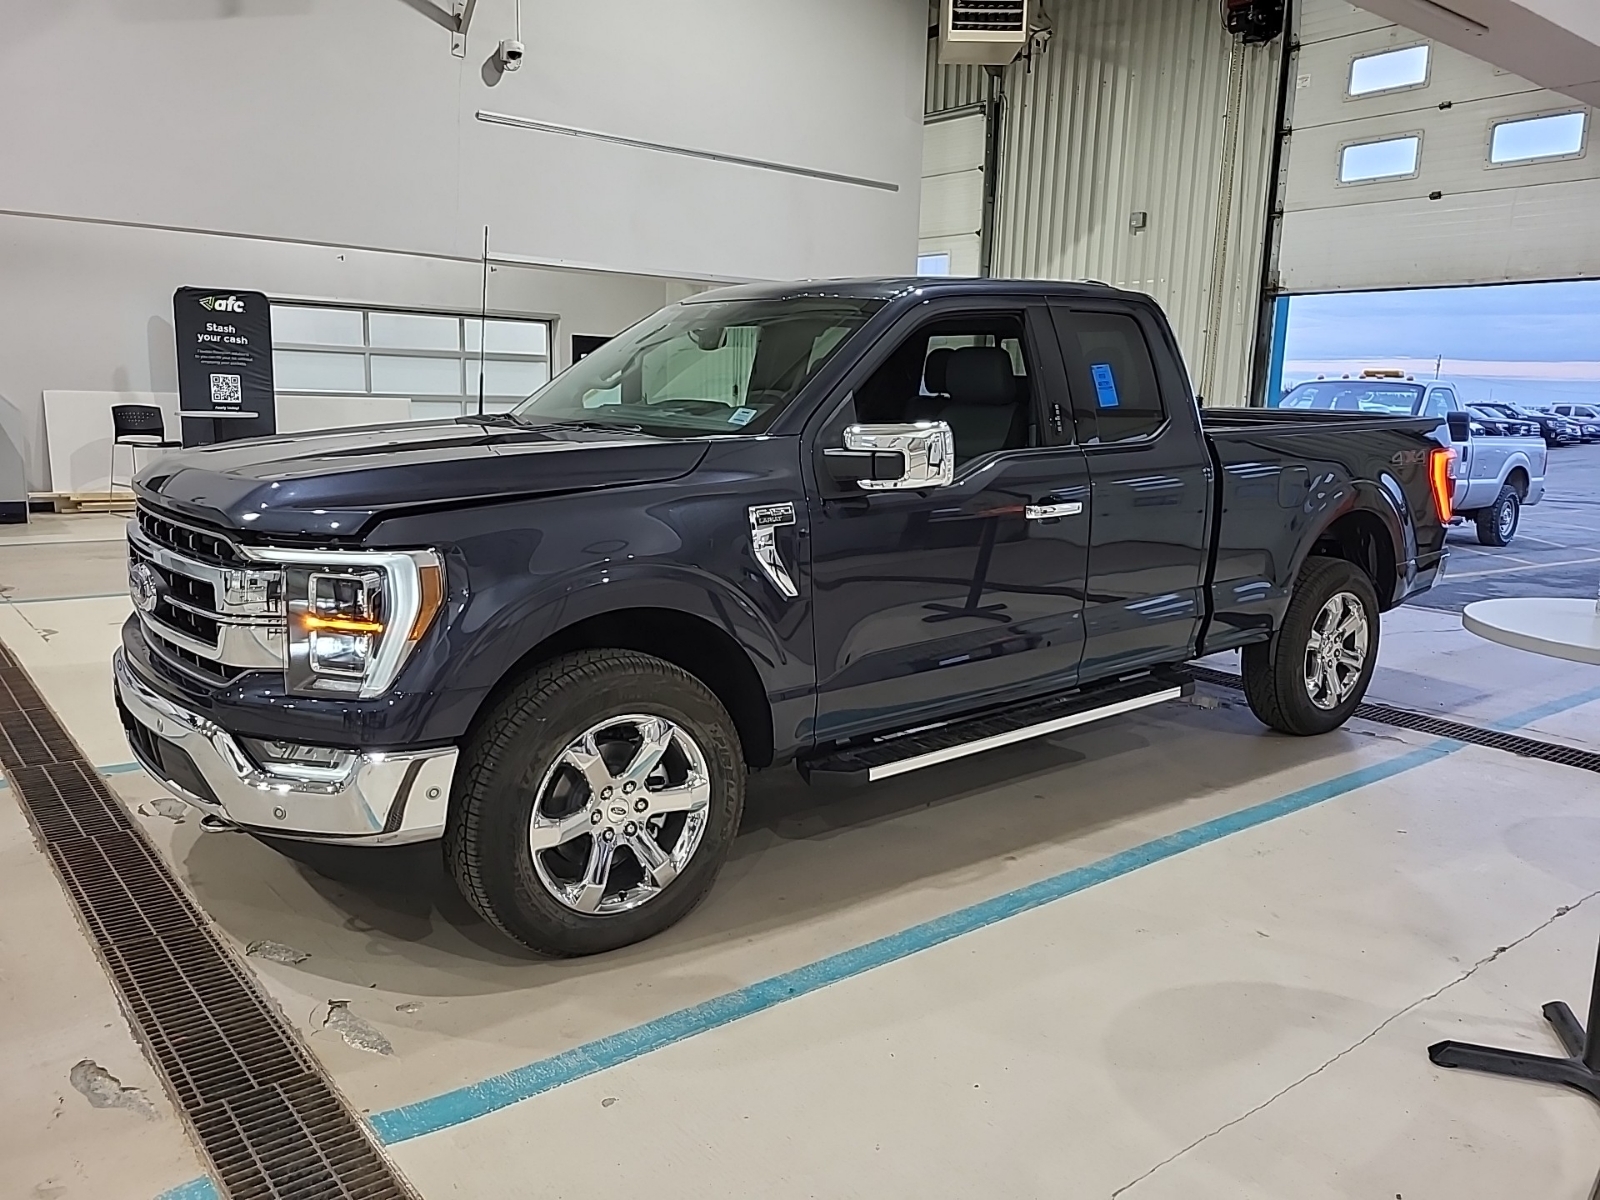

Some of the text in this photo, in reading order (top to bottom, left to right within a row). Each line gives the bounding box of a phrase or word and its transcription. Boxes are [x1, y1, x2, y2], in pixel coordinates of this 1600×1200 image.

[214, 295, 245, 313] afc
[206, 322, 236, 334] Stash
[197, 333, 248, 345] your cash
